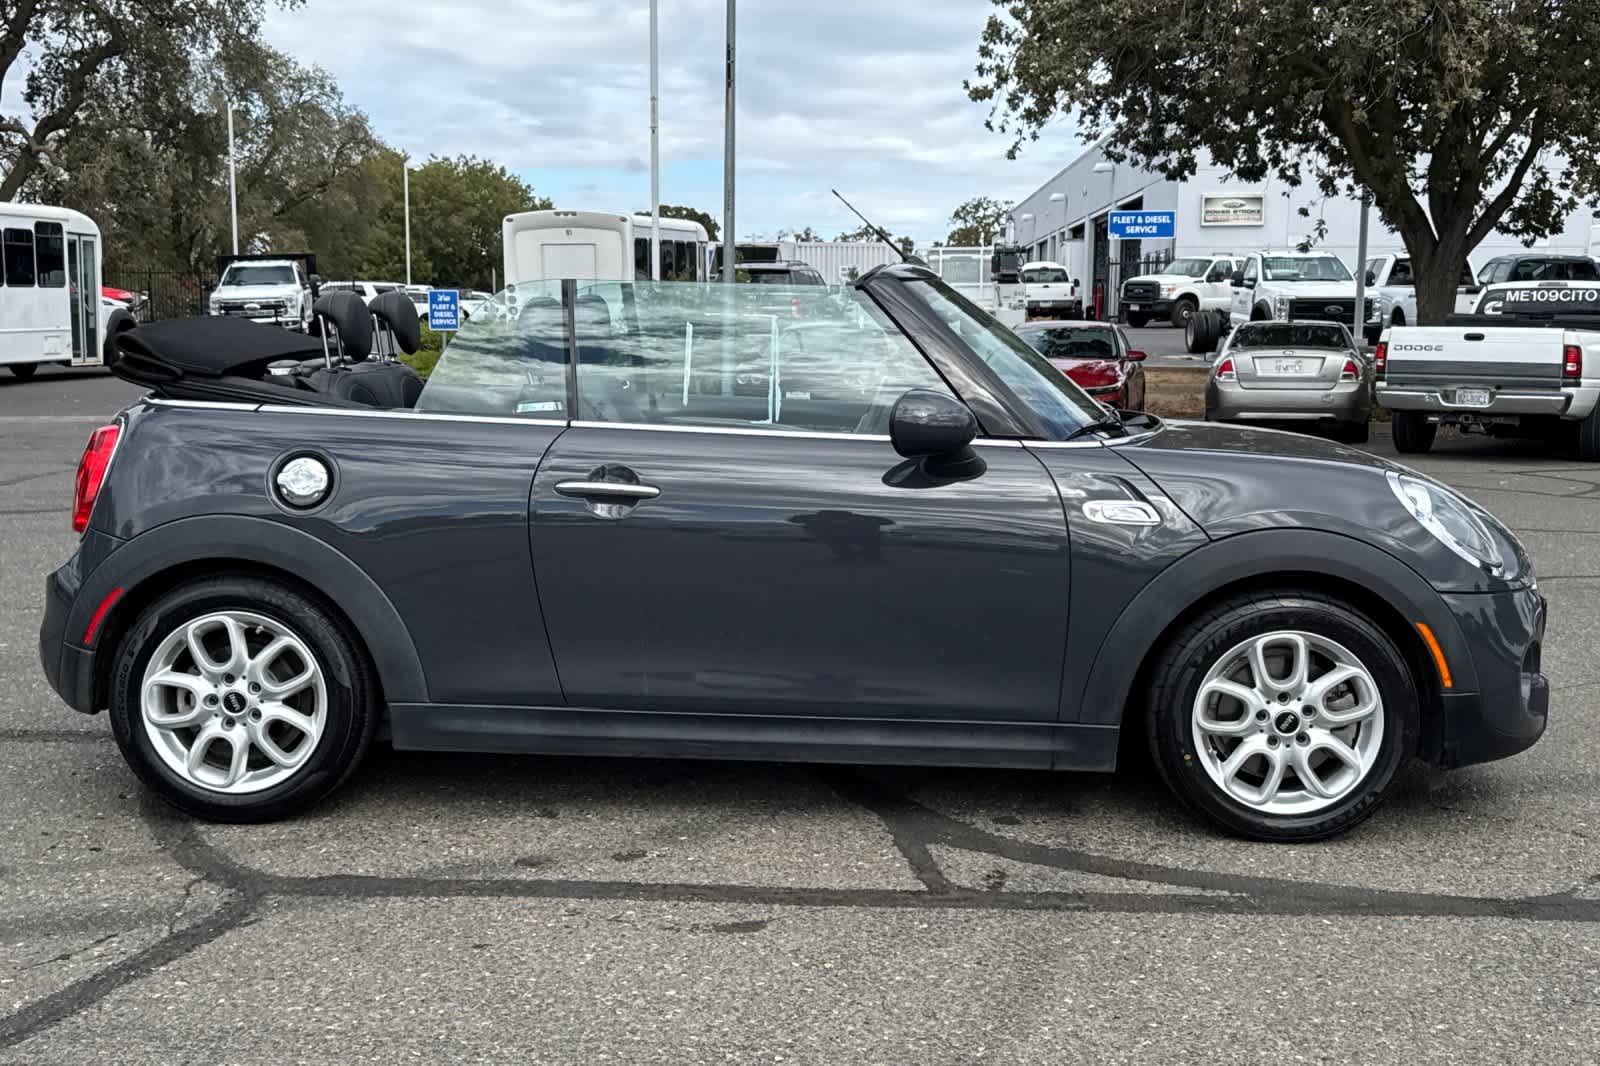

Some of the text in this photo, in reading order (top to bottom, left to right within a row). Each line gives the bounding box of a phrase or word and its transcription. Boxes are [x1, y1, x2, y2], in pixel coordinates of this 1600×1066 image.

[1112, 215, 1136, 224] FLEET
[1145, 215, 1172, 224] DIESEL
[1125, 225, 1158, 234] SERVICE
[1505, 289, 1598, 302] ME109CITO
[1393, 344, 1444, 352] DODGE
